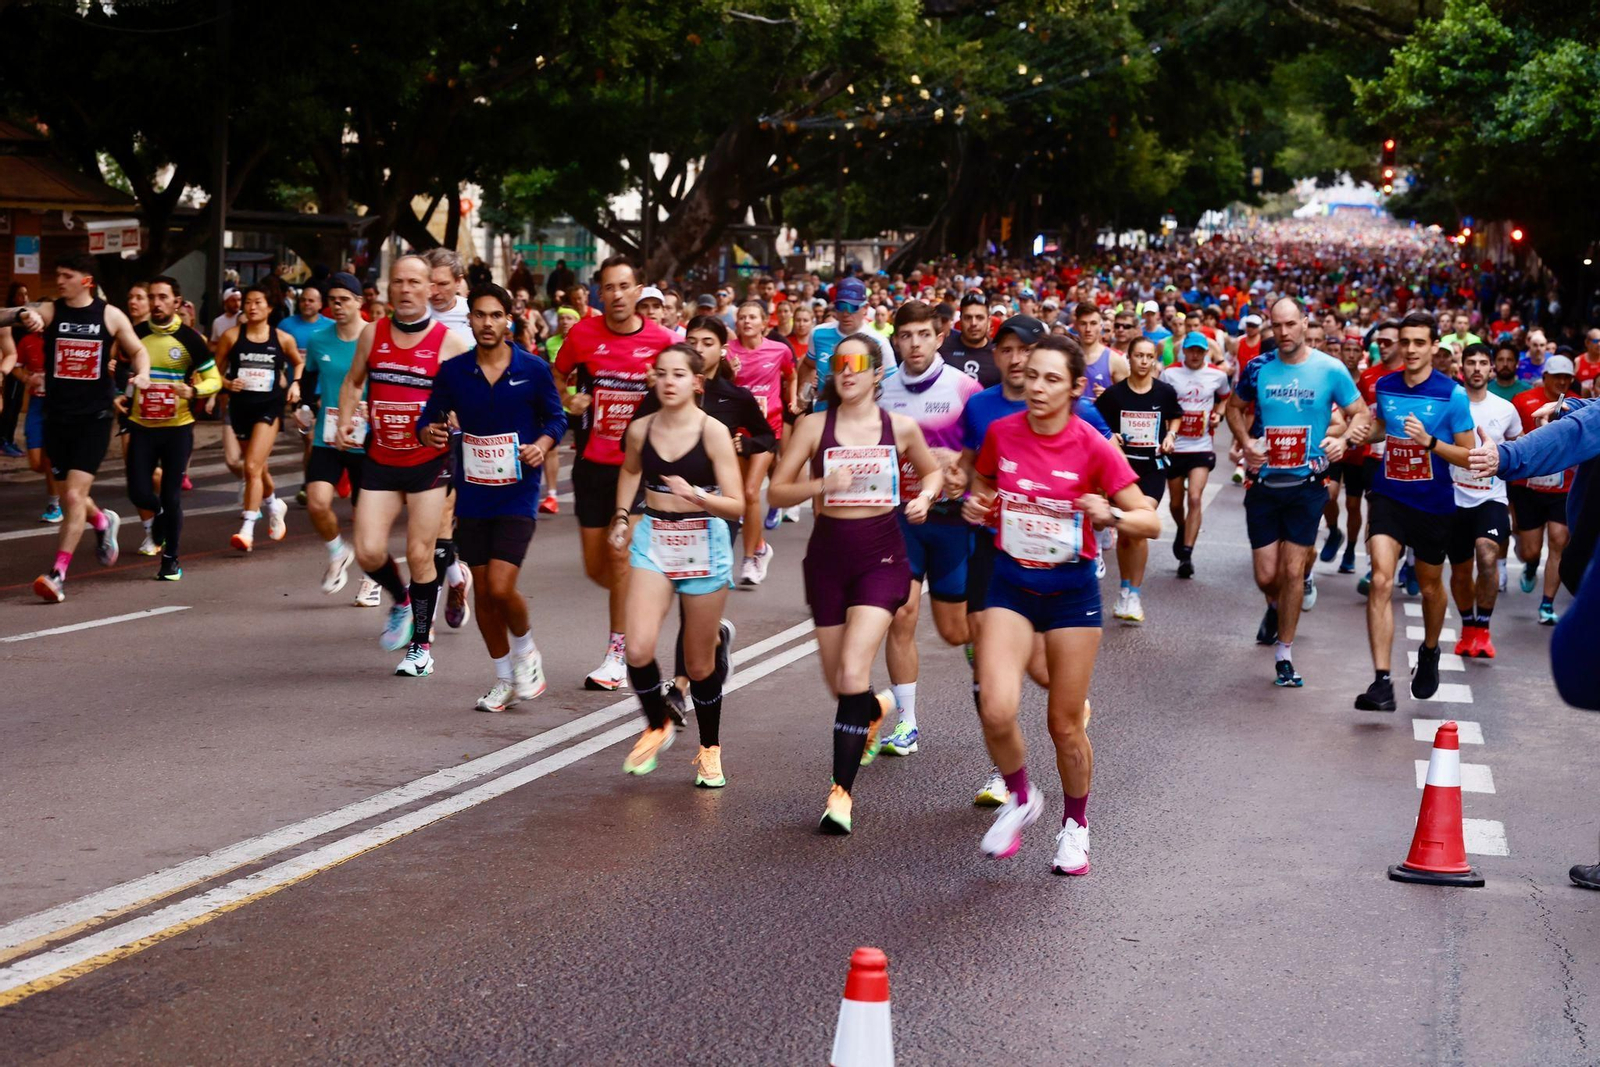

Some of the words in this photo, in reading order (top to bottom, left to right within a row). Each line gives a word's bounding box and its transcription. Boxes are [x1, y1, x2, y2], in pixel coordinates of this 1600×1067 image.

[606, 403, 635, 415] 4539
[382, 413, 411, 424] 5193
[1127, 420, 1152, 428] 15665
[471, 447, 505, 459] 18510
[1392, 447, 1414, 458] 6711
